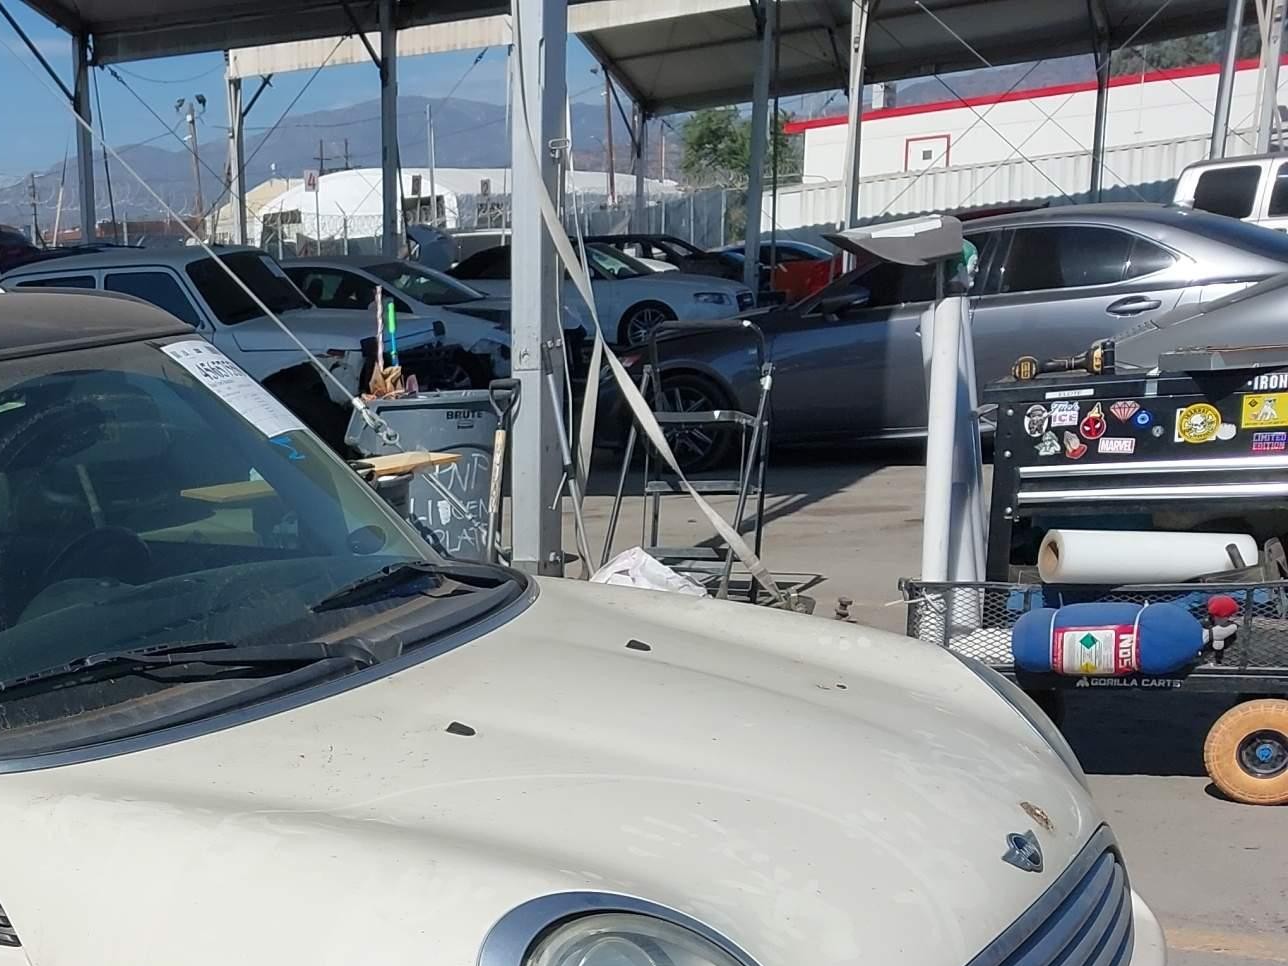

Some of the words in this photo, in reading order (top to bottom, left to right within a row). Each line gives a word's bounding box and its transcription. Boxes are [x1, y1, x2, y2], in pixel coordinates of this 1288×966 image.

[1253, 374, 1288, 390] IRON
[446, 410, 483, 420] BRUTE
[1253, 433, 1287, 442] LIMITED
[1100, 440, 1134, 452] MARVEL
[1253, 442, 1286, 450] EDITION
[1118, 633, 1135, 669] NOS
[1090, 678, 1138, 687] GORILLA
